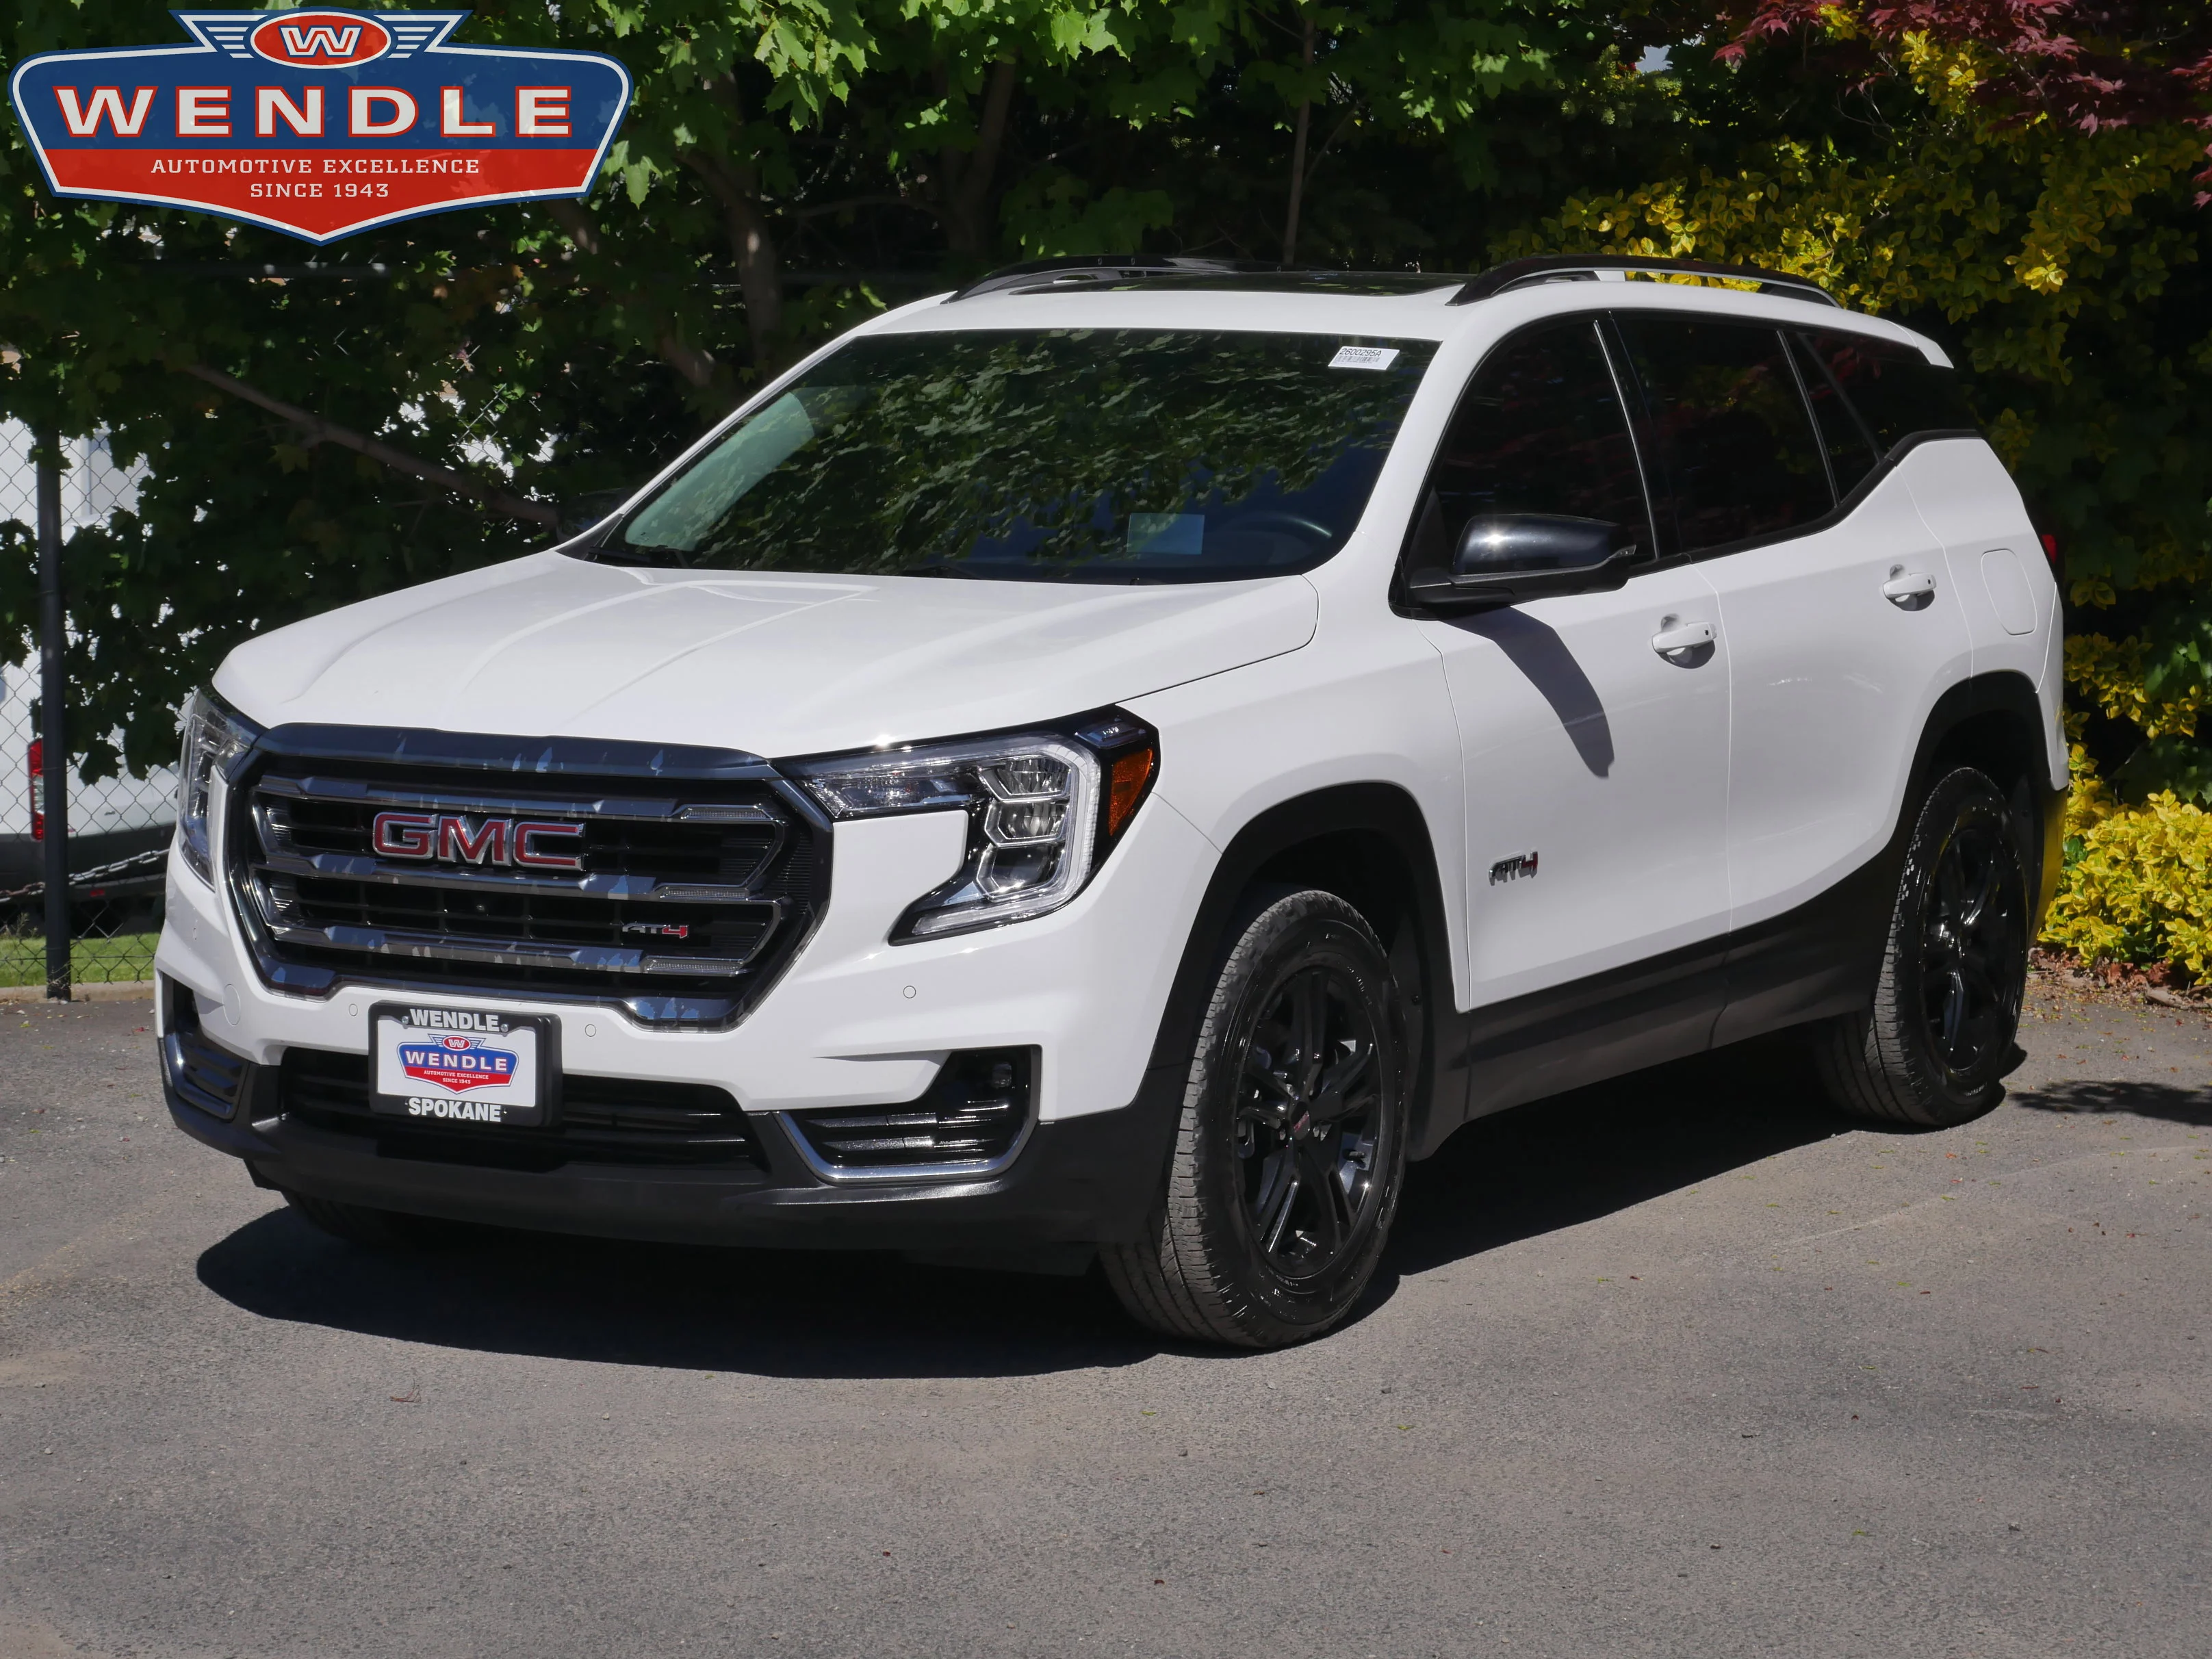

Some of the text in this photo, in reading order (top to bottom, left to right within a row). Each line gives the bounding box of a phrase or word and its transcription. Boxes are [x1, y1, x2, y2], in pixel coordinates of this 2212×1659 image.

[1339, 348, 1382, 357] 2600295A
[372, 811, 585, 871] GMC
[1489, 851, 1539, 882] AT4
[621, 923, 689, 939] AT4
[409, 1008, 500, 1031] WENDLE
[404, 1050, 508, 1072] WENDLE
[408, 1096, 502, 1122] SPOKANE
